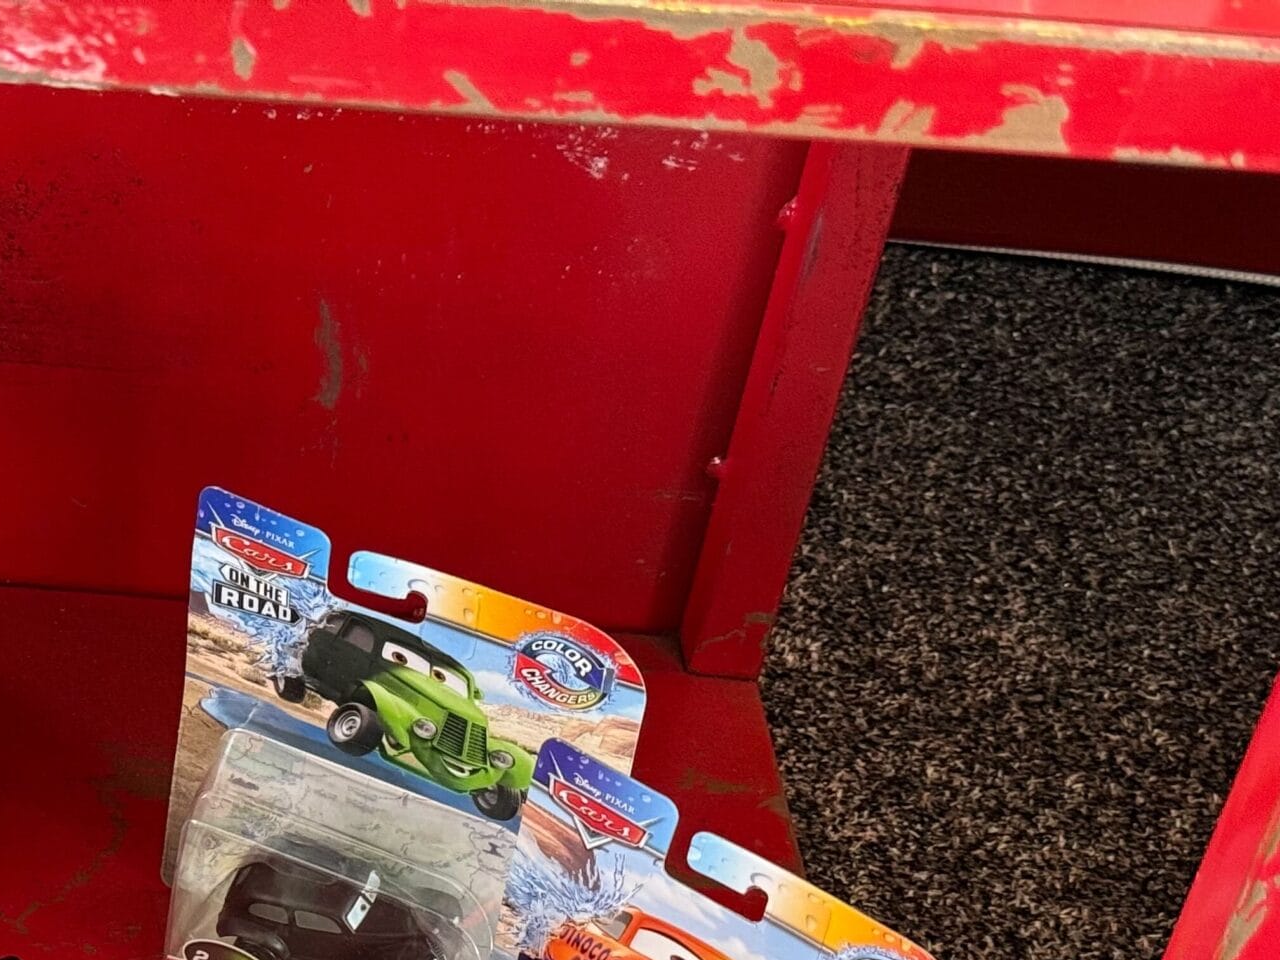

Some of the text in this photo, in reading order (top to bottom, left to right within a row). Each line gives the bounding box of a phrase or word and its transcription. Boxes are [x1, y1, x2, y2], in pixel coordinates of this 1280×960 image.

[222, 535, 293, 571] Cars
[265, 531, 295, 549] PIXAR
[220, 585, 292, 622] ROAD
[229, 567, 284, 604] ON THE
[531, 639, 593, 677] COLOR
[519, 668, 597, 704] CHANGERS
[559, 789, 631, 837] Cars
[605, 793, 636, 815] PIXAR
